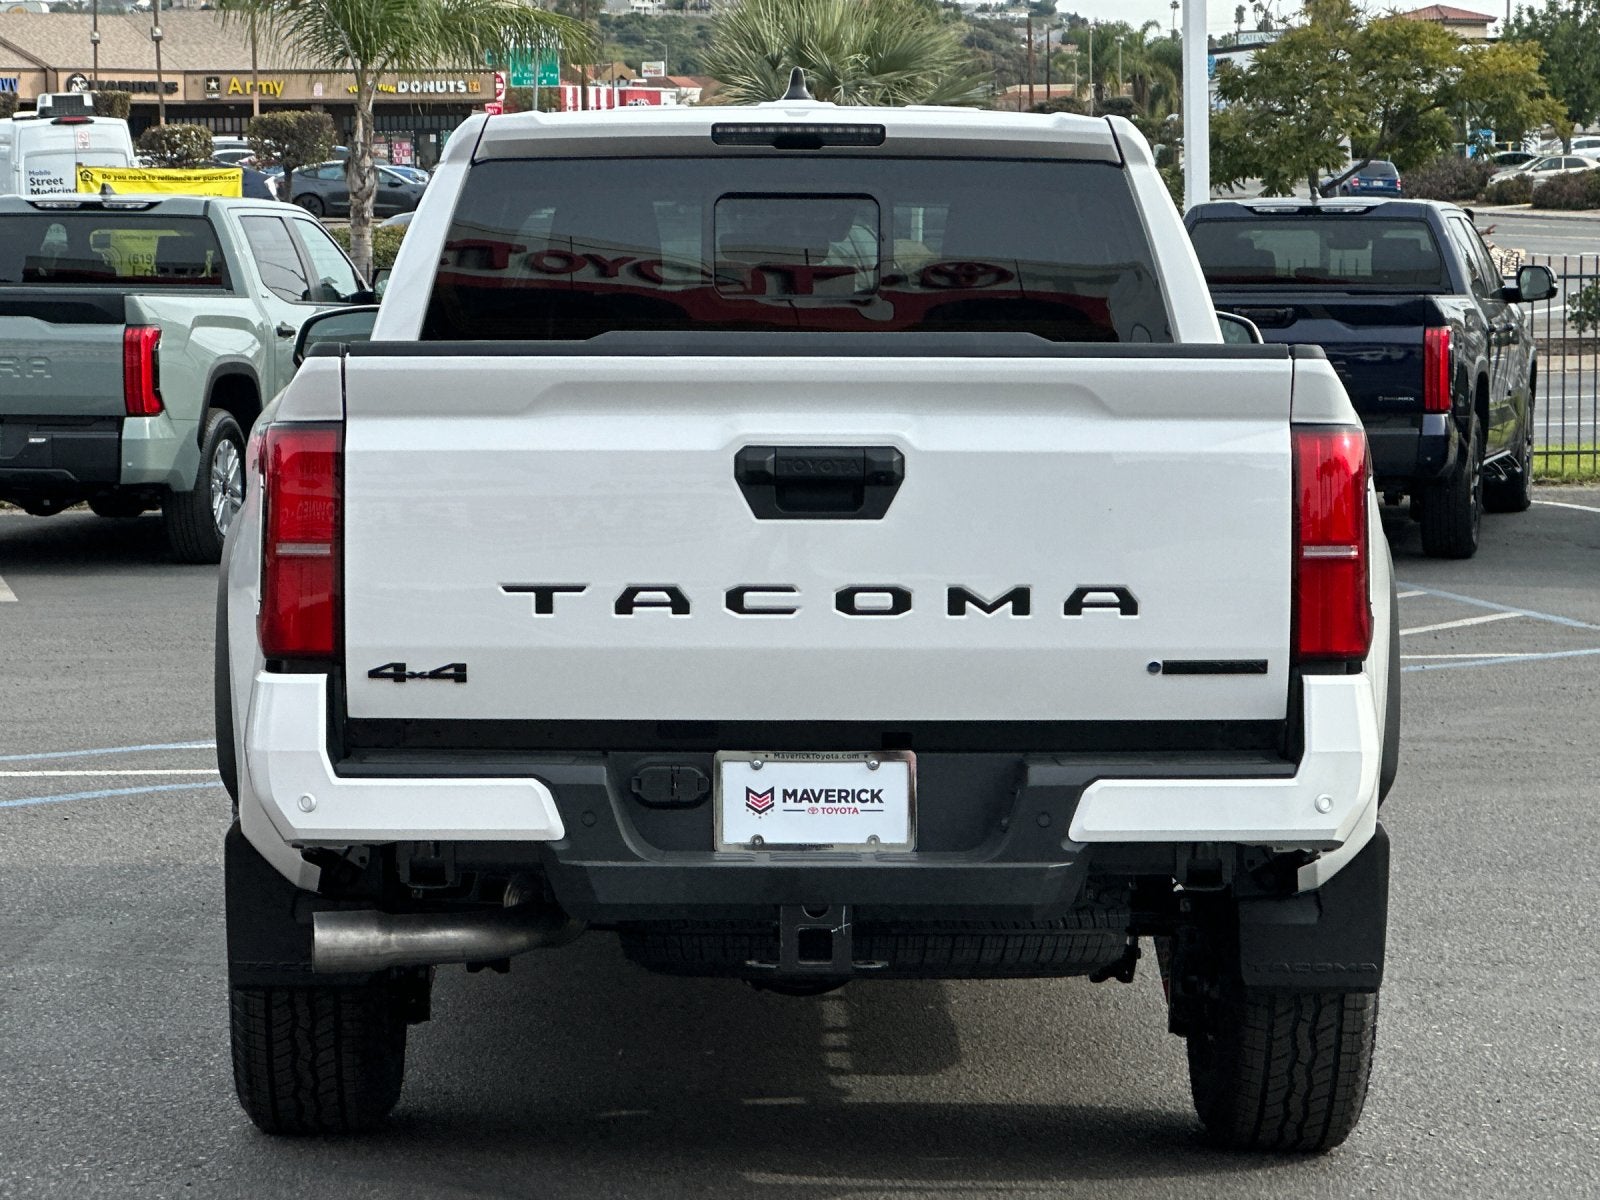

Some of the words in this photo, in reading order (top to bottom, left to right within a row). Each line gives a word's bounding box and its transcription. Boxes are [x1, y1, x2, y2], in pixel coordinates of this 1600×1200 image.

[88, 80, 179, 94] MARINS
[228, 76, 285, 98] Army
[377, 83, 397, 94] YUM
[397, 80, 467, 93] DONUTS
[29, 177, 64, 186] Street
[114, 174, 127, 182] you
[157, 174, 192, 182] refinance
[779, 457, 862, 475] TOYOTA
[500, 583, 1140, 615] TACOMA
[773, 752, 860, 760] MaverickToyota.com
[782, 788, 884, 804] MAVERICK
[820, 807, 860, 815] TOYOTA
